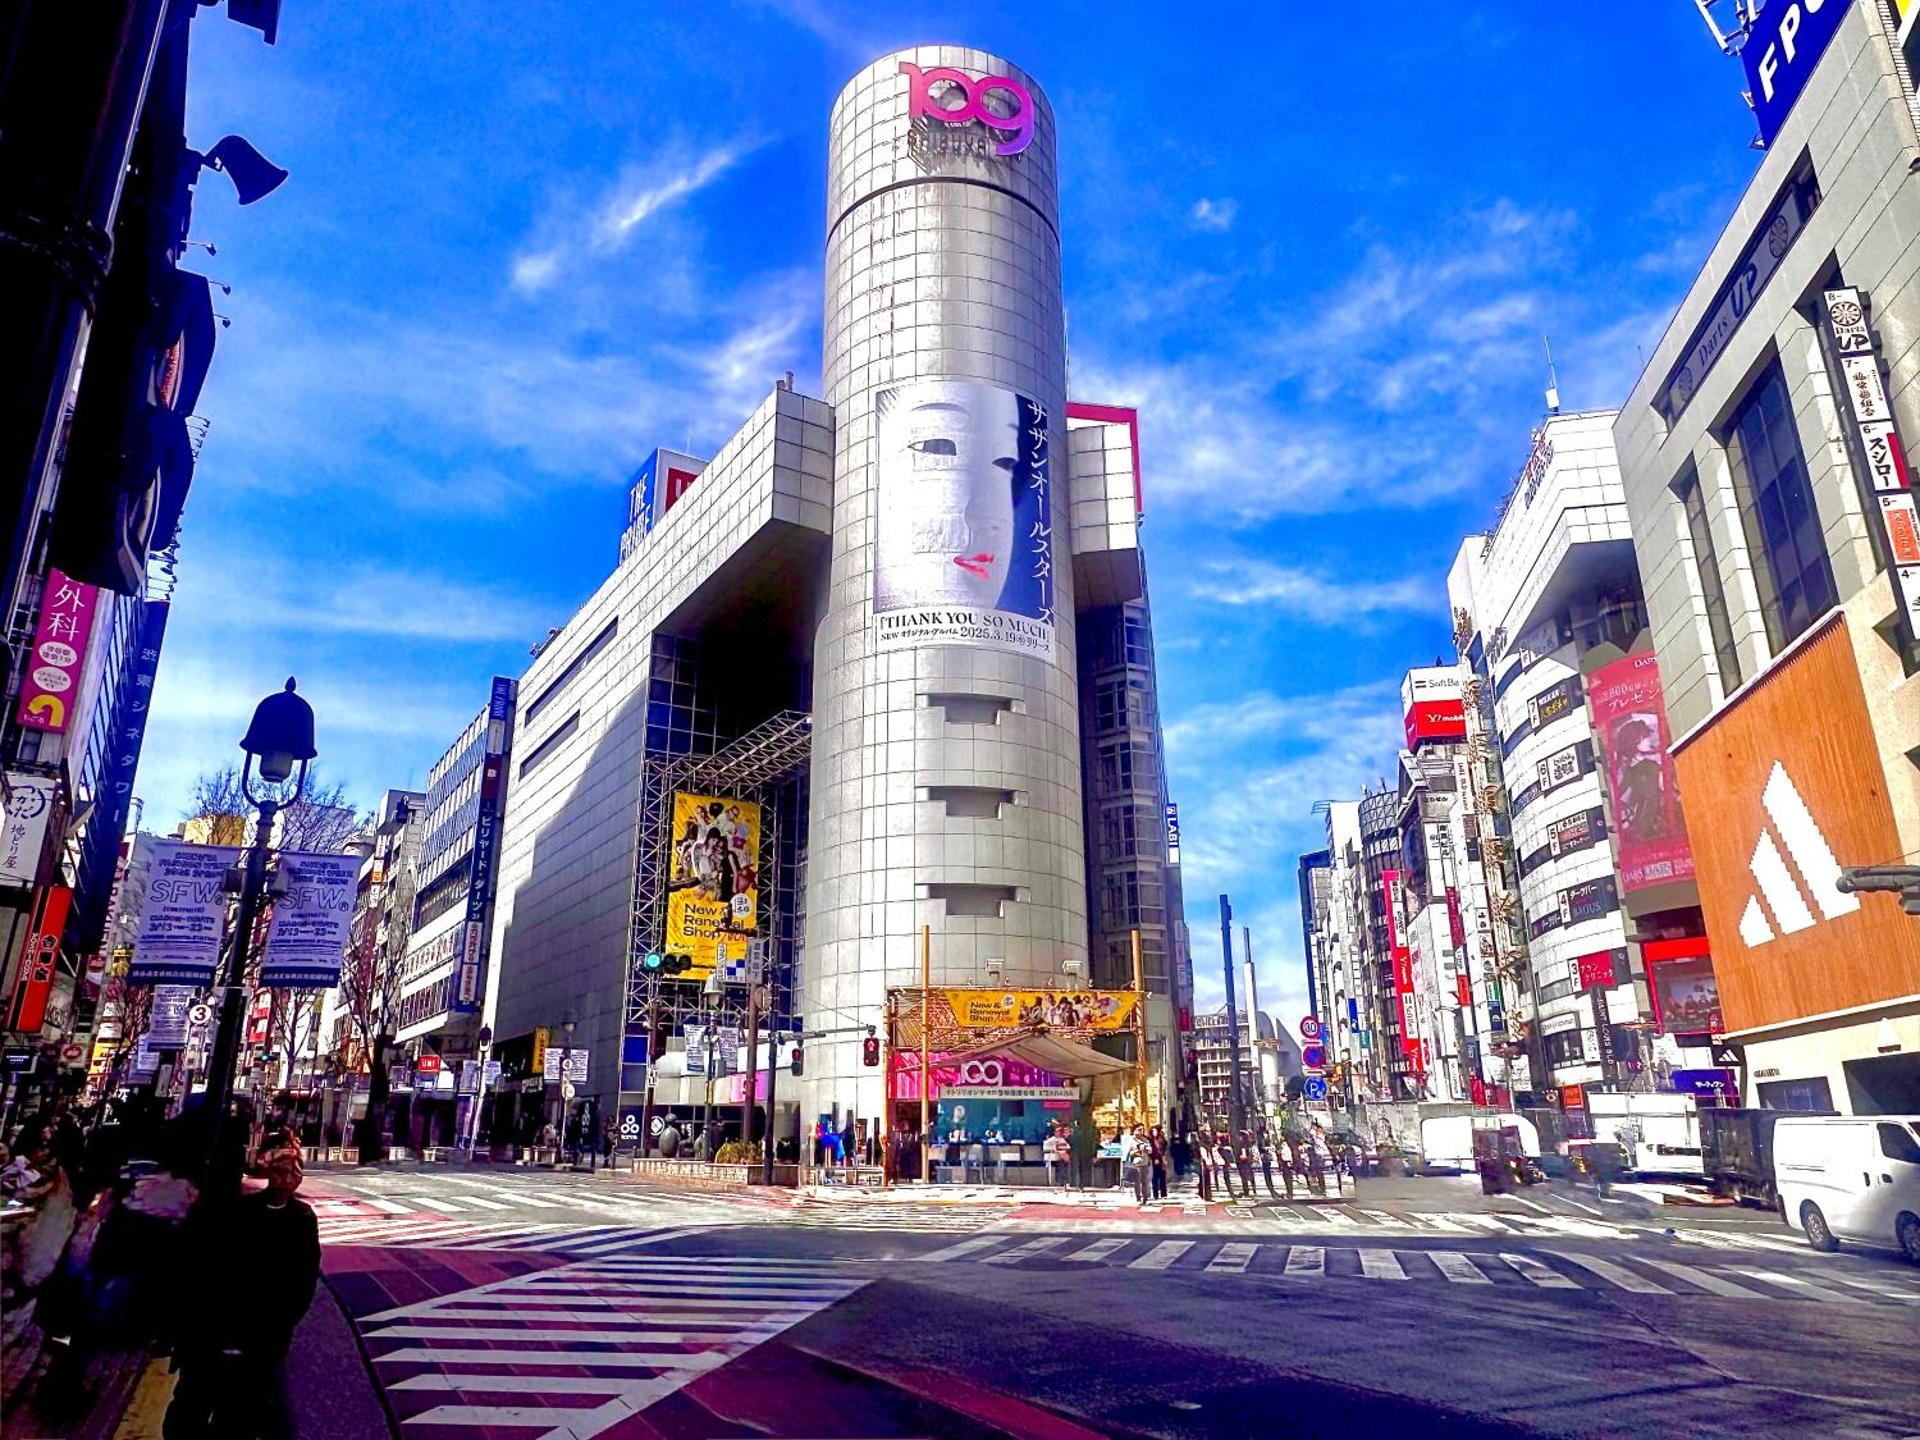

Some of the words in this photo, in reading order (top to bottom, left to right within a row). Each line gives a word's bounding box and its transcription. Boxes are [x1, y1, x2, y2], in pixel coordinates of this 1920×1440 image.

[899, 61, 1034, 156] 109
[1699, 317, 1729, 367] Darts
[1731, 261, 1758, 319] UP
[1836, 326, 1865, 334] Darts
[1837, 334, 1869, 350] UP
[1868, 437, 1891, 487] スシロー
[1026, 400, 1053, 626] サザンオールスターズ
[48, 584, 85, 642] 外科
[946, 612, 977, 625] YOU
[983, 614, 1003, 628] SO
[113, 648, 157, 822] 渋東シネタワー
[1167, 817, 1178, 845] LABI
[683, 915, 745, 930] Reneal
[683, 926, 720, 941] Shop
[194, 1006, 206, 1020] 3
[961, 1060, 1003, 1088] 109
[1310, 1082, 1319, 1094] P
